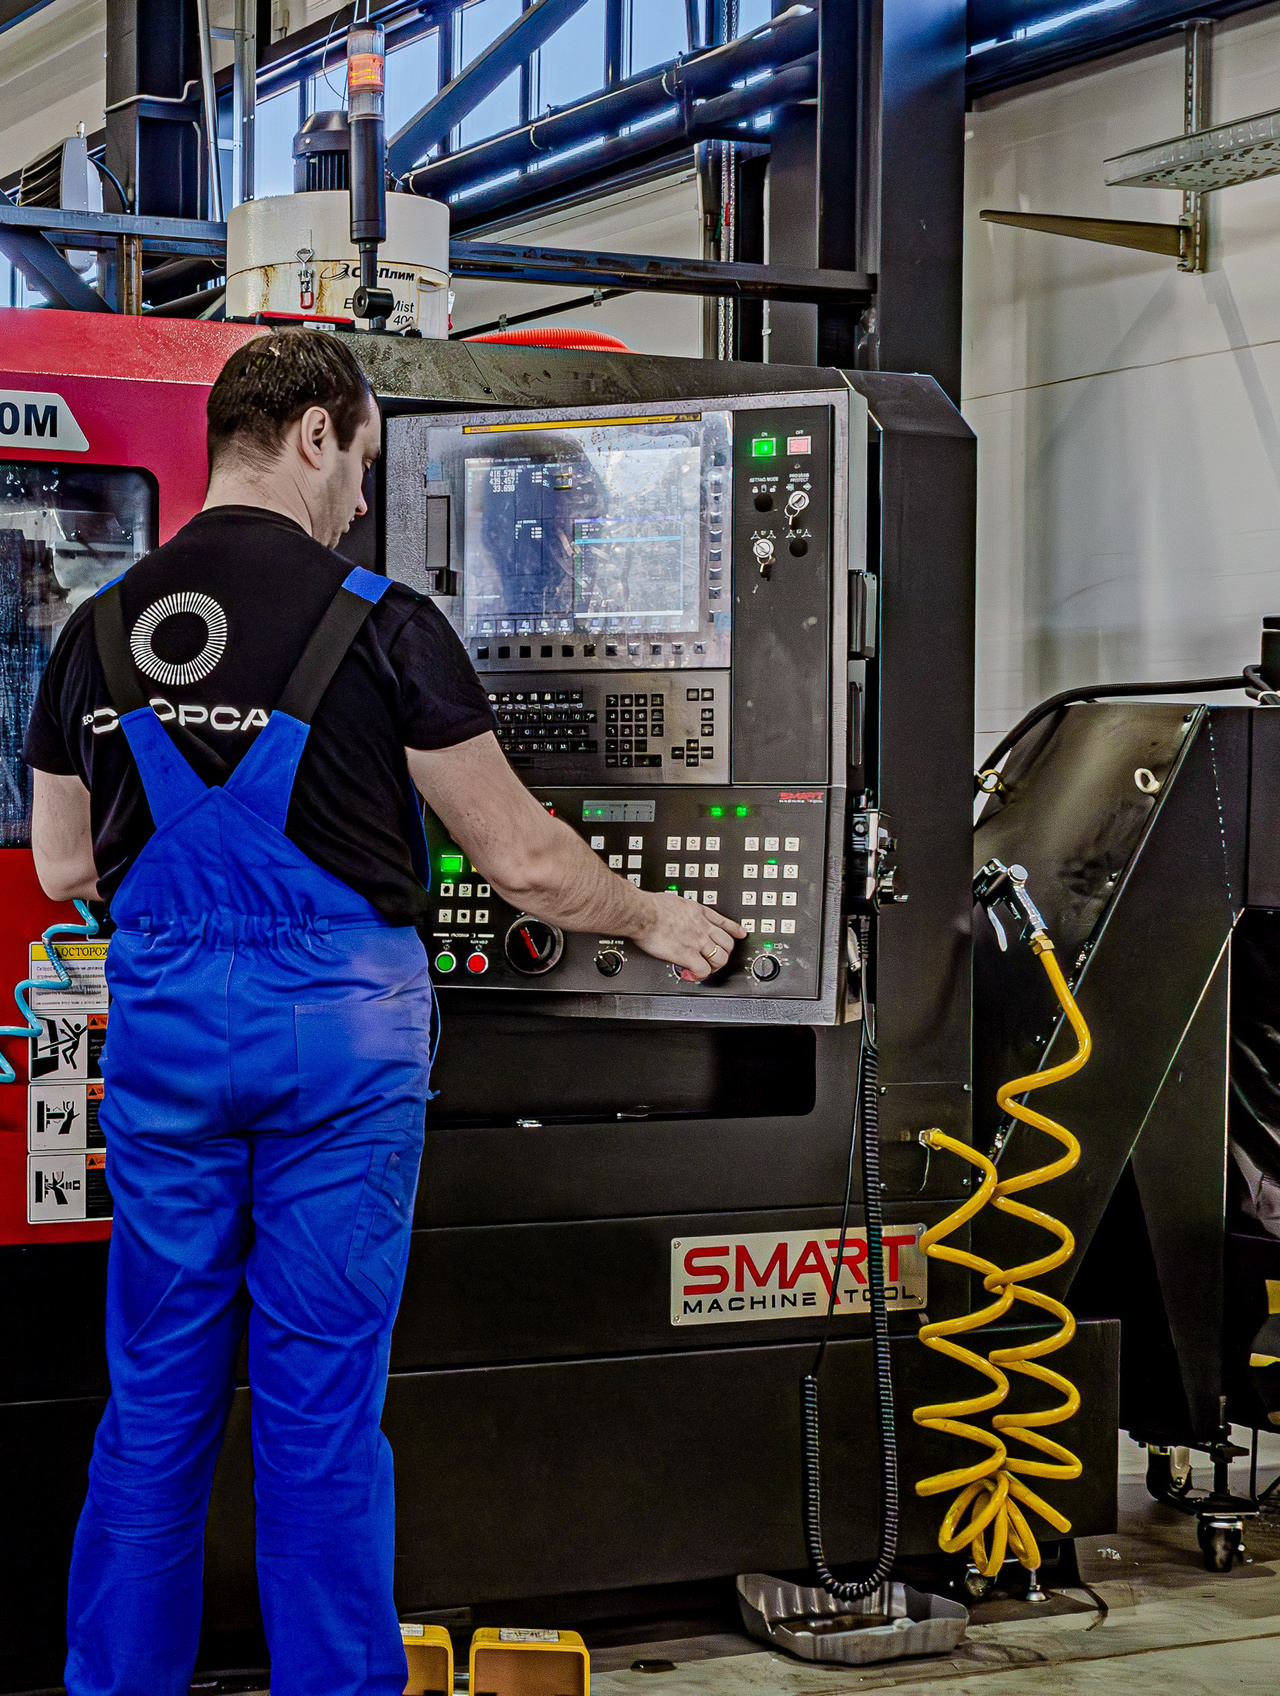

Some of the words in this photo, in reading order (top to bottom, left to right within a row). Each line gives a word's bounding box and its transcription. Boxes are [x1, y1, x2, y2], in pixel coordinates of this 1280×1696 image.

[351, 266, 415, 281] СПлим
[683, 1234, 916, 1305] SMART
[683, 1291, 817, 1314] MACHINE
